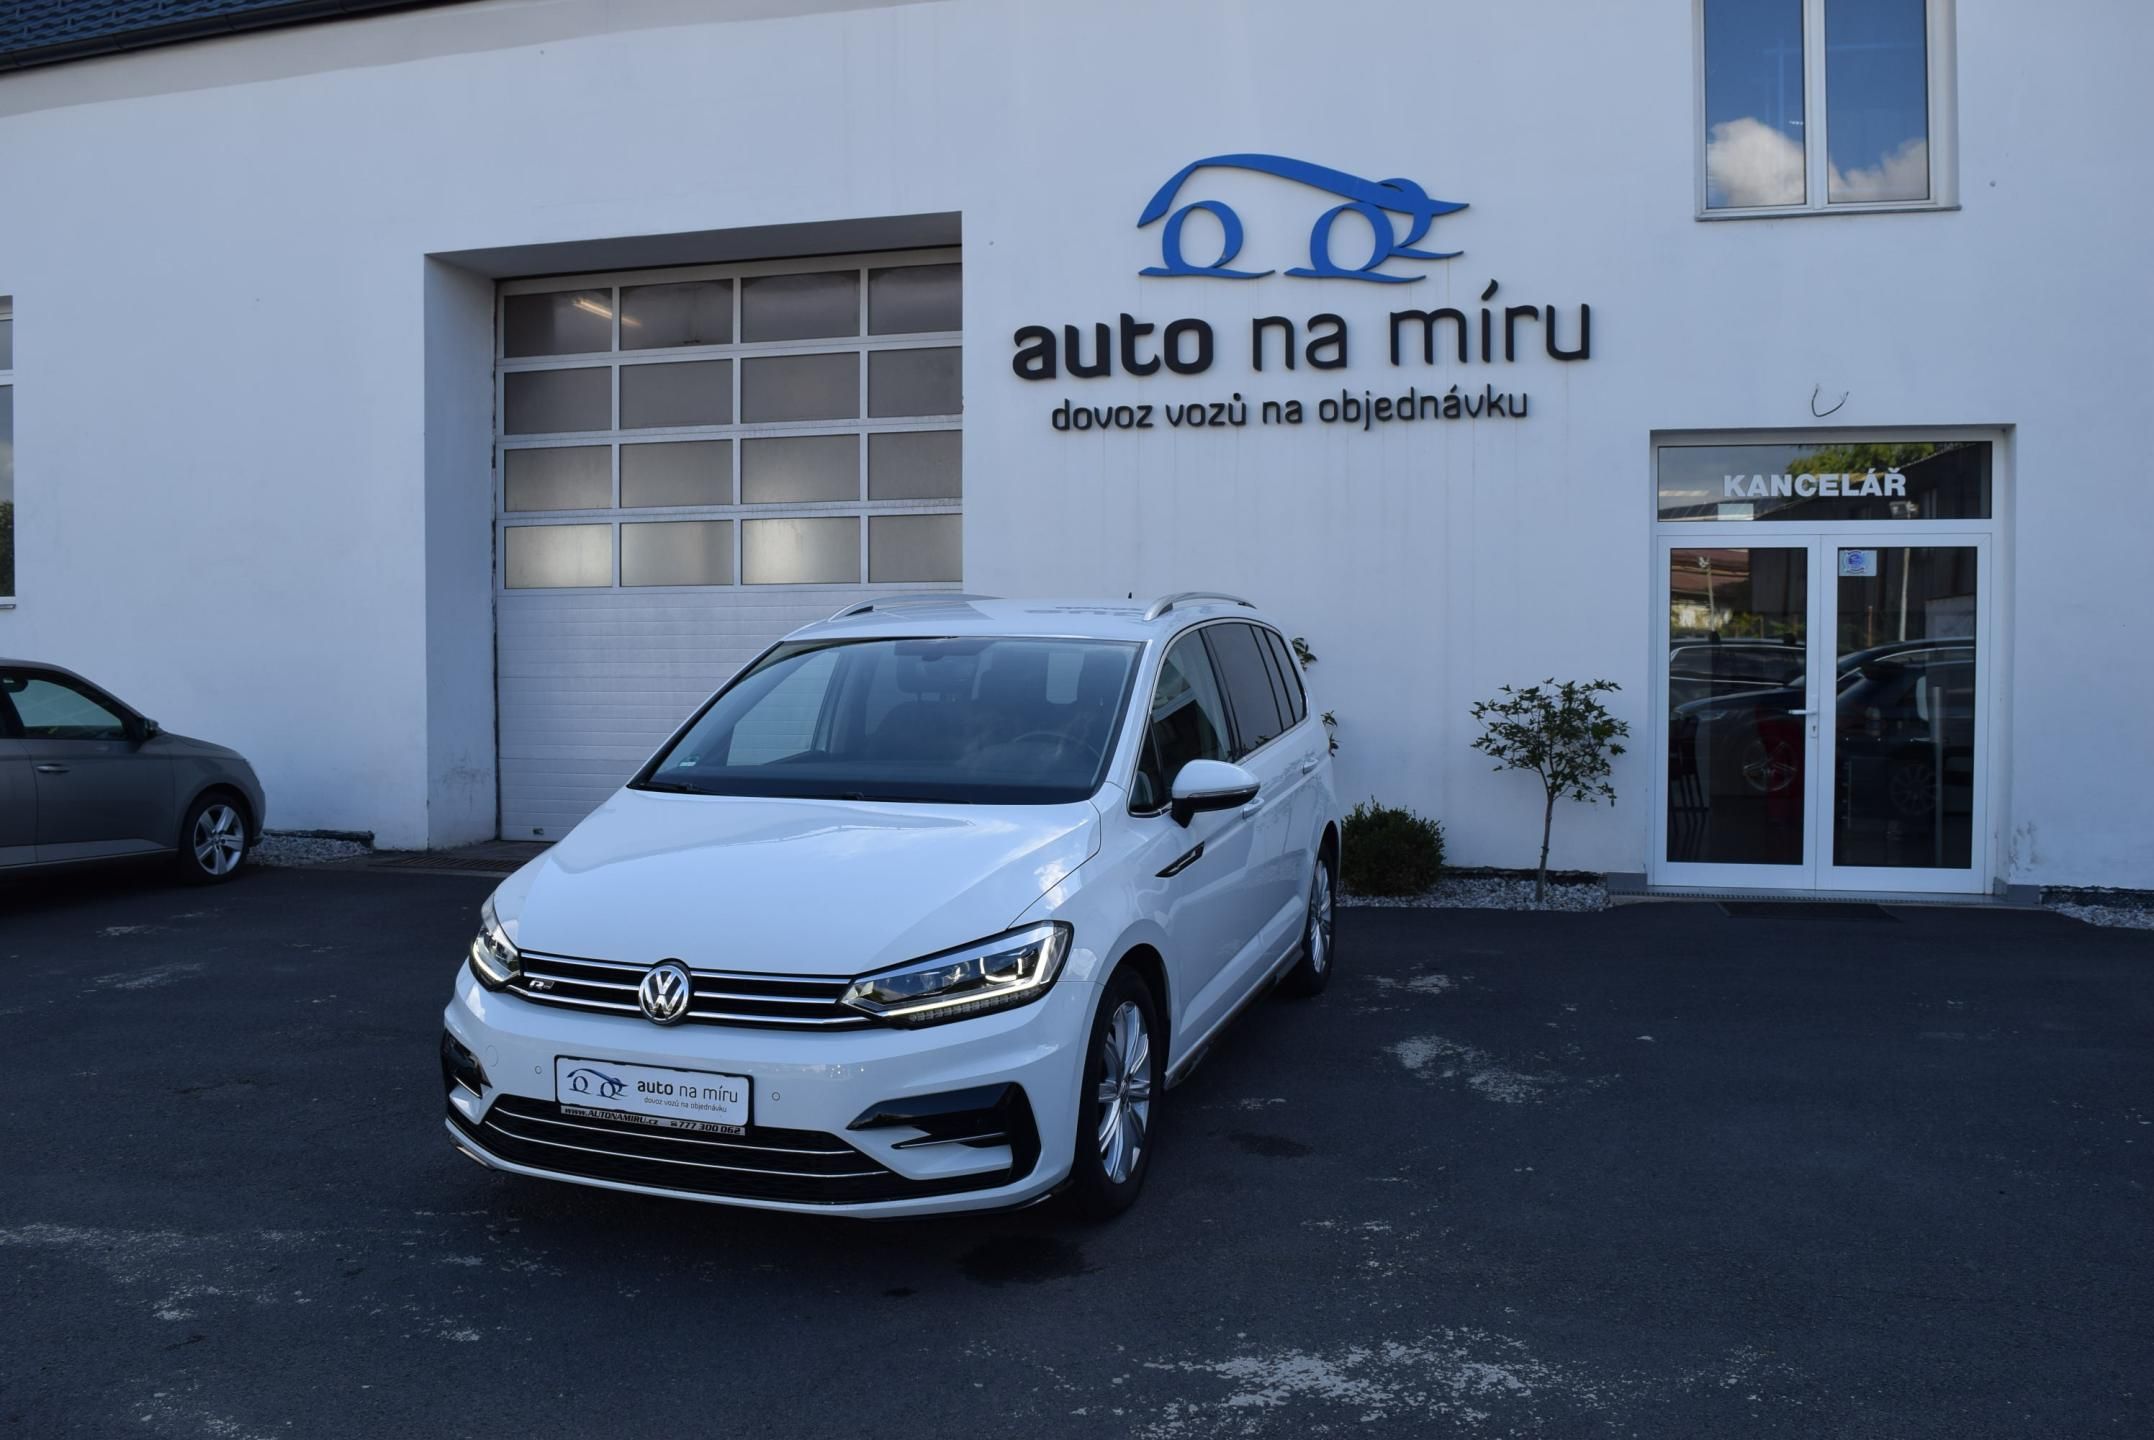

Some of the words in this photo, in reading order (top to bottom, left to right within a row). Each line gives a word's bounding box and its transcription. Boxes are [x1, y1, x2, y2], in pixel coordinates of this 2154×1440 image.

[1012, 313, 1214, 380] auto
[1252, 312, 1348, 371] na
[1390, 279, 1591, 367] míru
[1051, 398, 1153, 431] dovoz
[1165, 392, 1247, 428] vozů
[1262, 398, 1303, 425] na
[1318, 384, 1529, 430] objednávku
[1723, 467, 1906, 498] KANCELÁŘ
[637, 1080, 674, 1096] auto
[679, 1085, 697, 1099] na
[703, 1085, 738, 1103] míru
[643, 1097, 661, 1105] dovoz
[681, 1101, 689, 1109] na
[690, 1102, 728, 1113] objednávku
